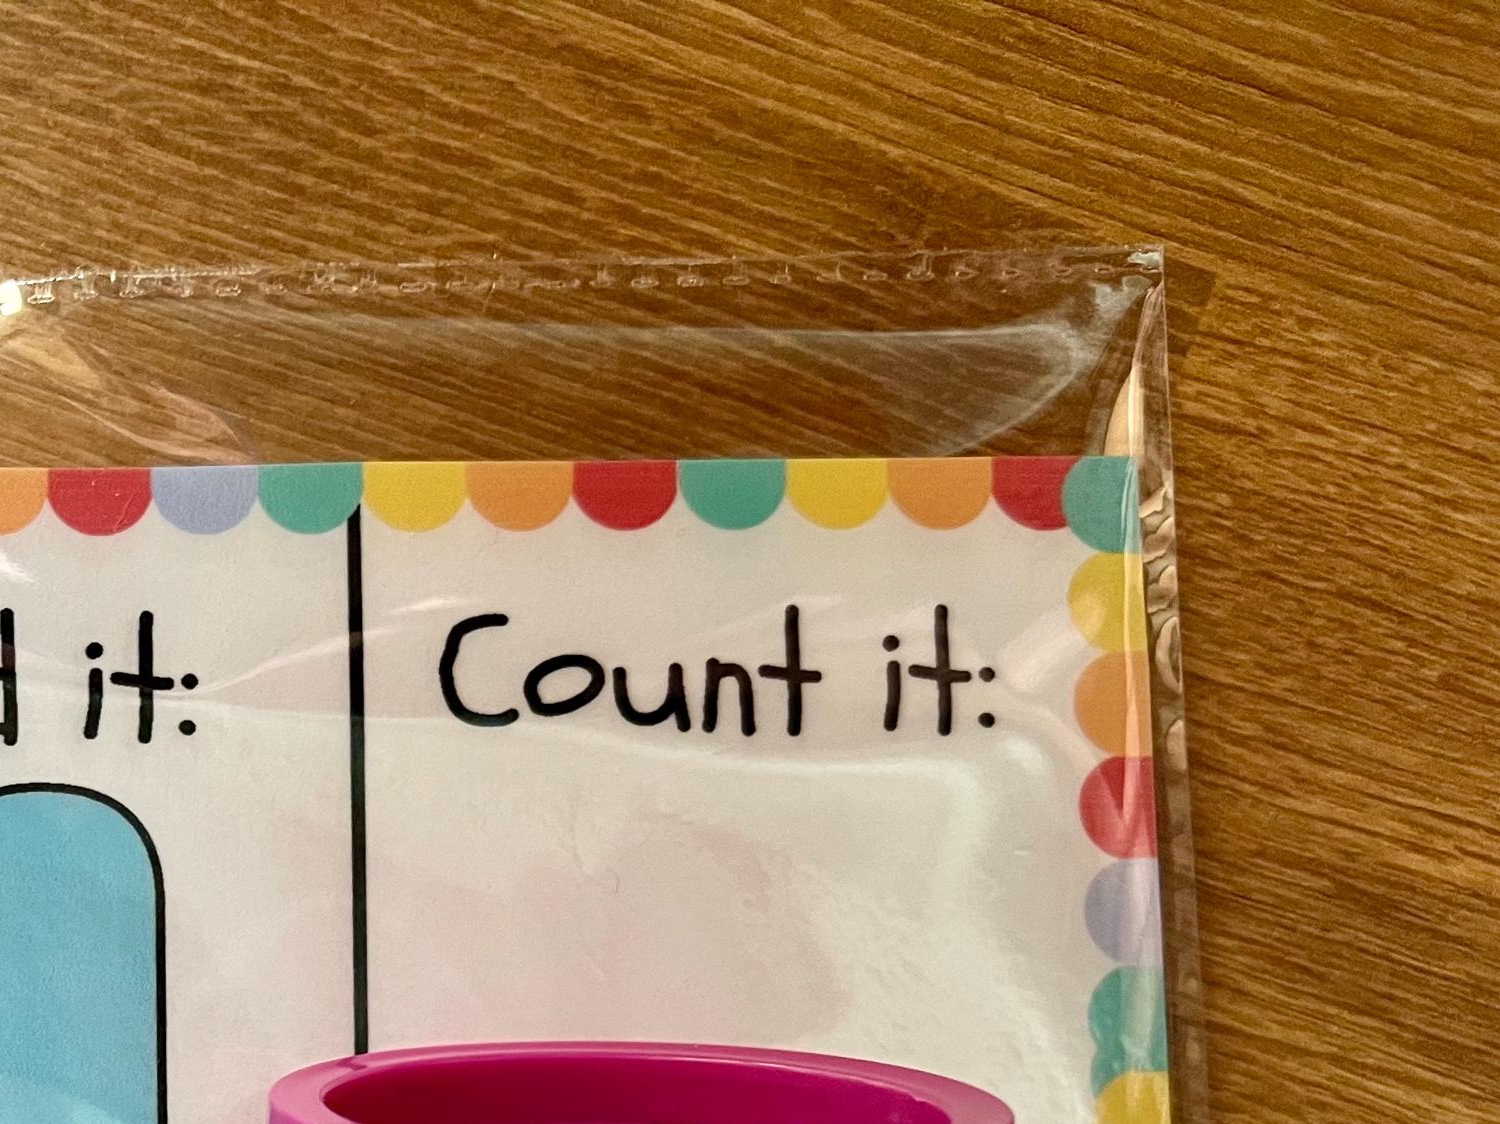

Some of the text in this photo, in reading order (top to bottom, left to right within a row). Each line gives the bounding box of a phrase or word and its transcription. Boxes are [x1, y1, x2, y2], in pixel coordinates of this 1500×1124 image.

[83, 610, 198, 744] it:
[439, 604, 995, 737] Count it:
